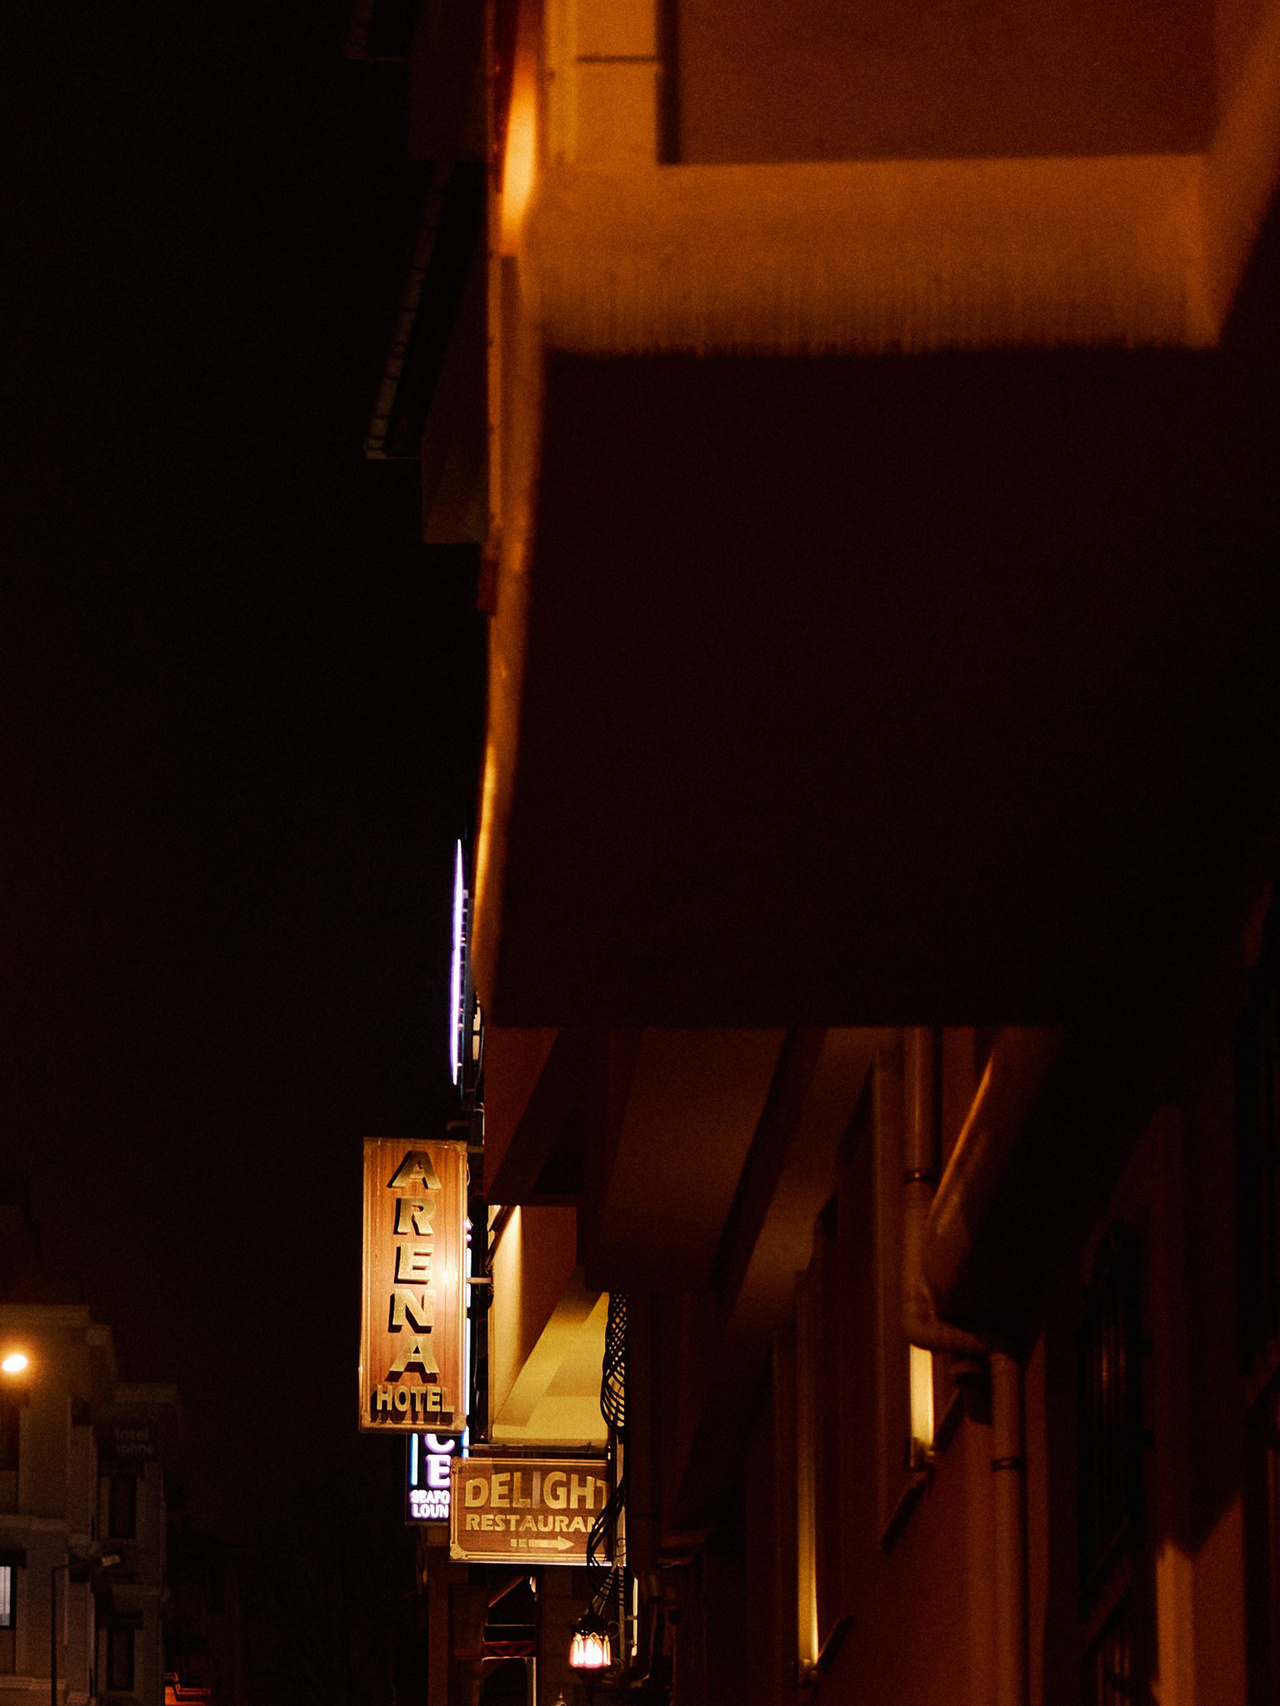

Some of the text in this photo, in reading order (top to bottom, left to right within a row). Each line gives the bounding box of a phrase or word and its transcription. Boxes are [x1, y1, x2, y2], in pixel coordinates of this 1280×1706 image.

[388, 1150, 442, 1374] ARENA
[376, 1385, 455, 1413] HOTEL
[410, 1489, 450, 1504] SEAFO
[412, 1503, 449, 1518] LOUN
